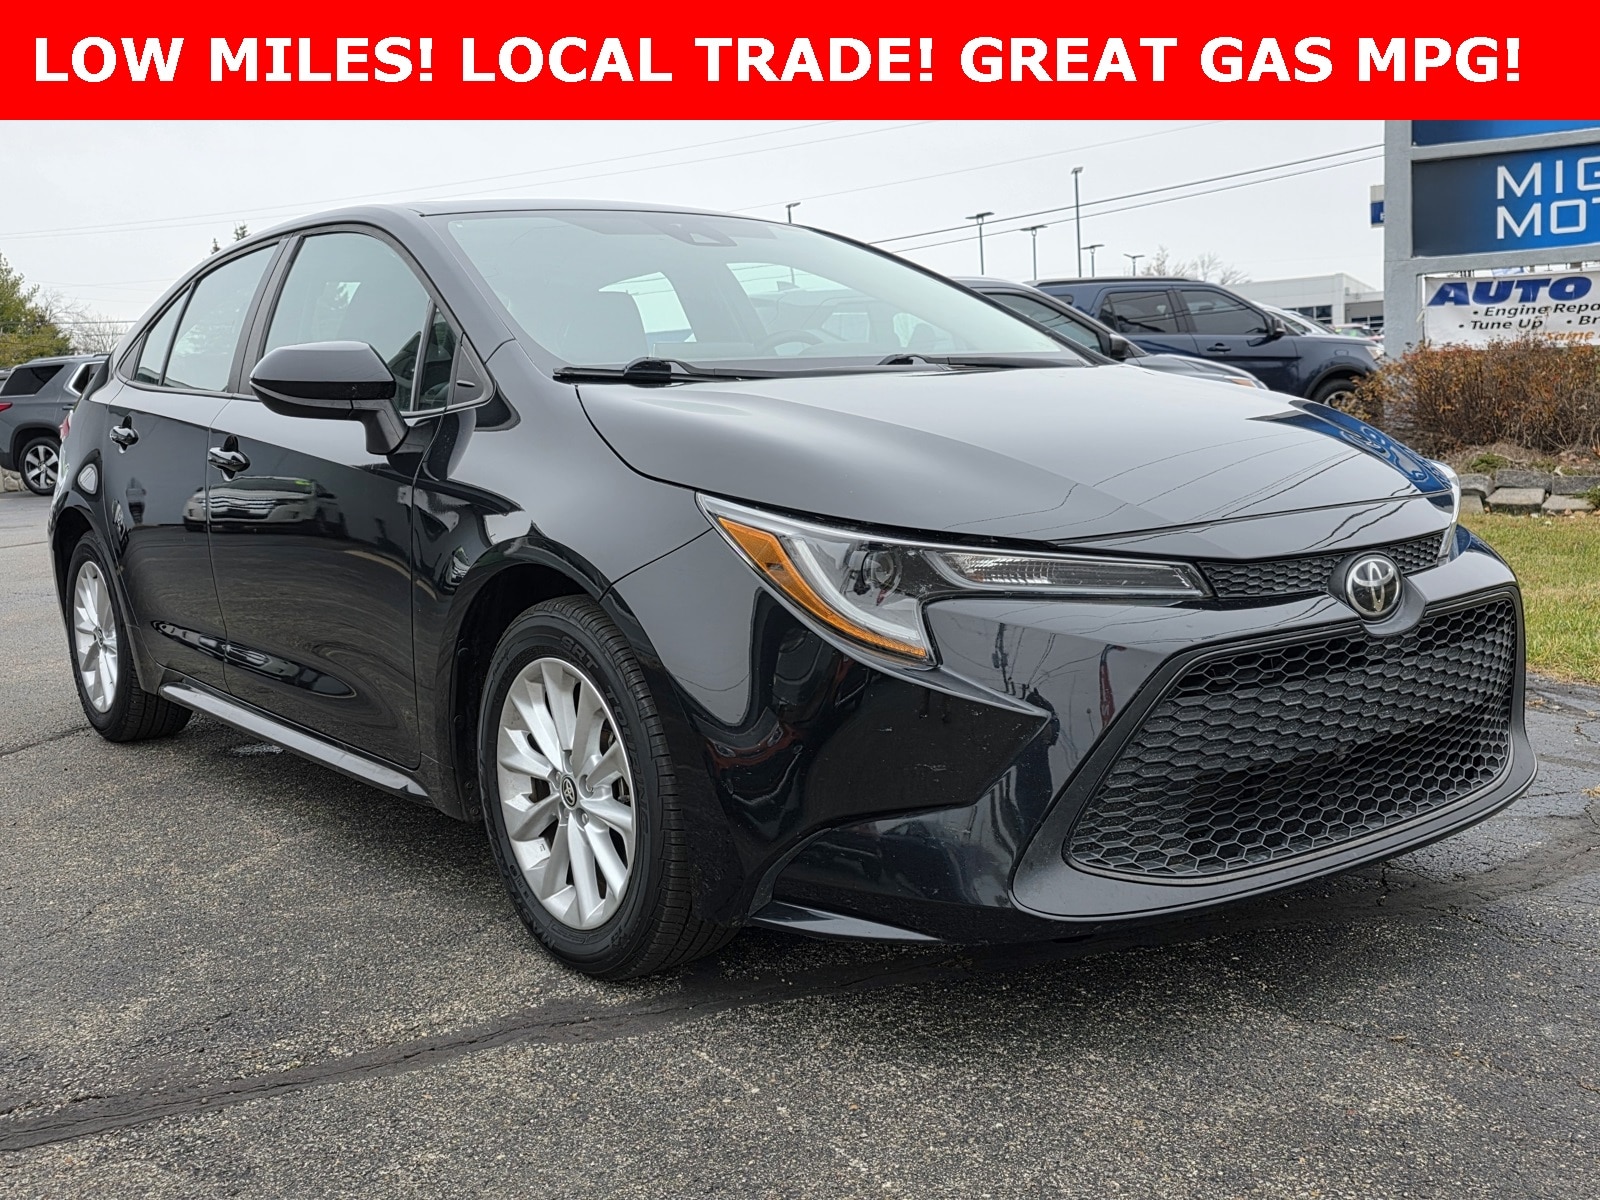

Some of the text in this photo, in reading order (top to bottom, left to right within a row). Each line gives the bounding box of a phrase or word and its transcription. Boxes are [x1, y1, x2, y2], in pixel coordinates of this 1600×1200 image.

[1497, 197, 1600, 240] MO
[1426, 276, 1593, 306] AUTO
[1471, 318, 1544, 331] Tune Up
[1484, 305, 1549, 318] Engine
[561, 636, 598, 668] SRT
